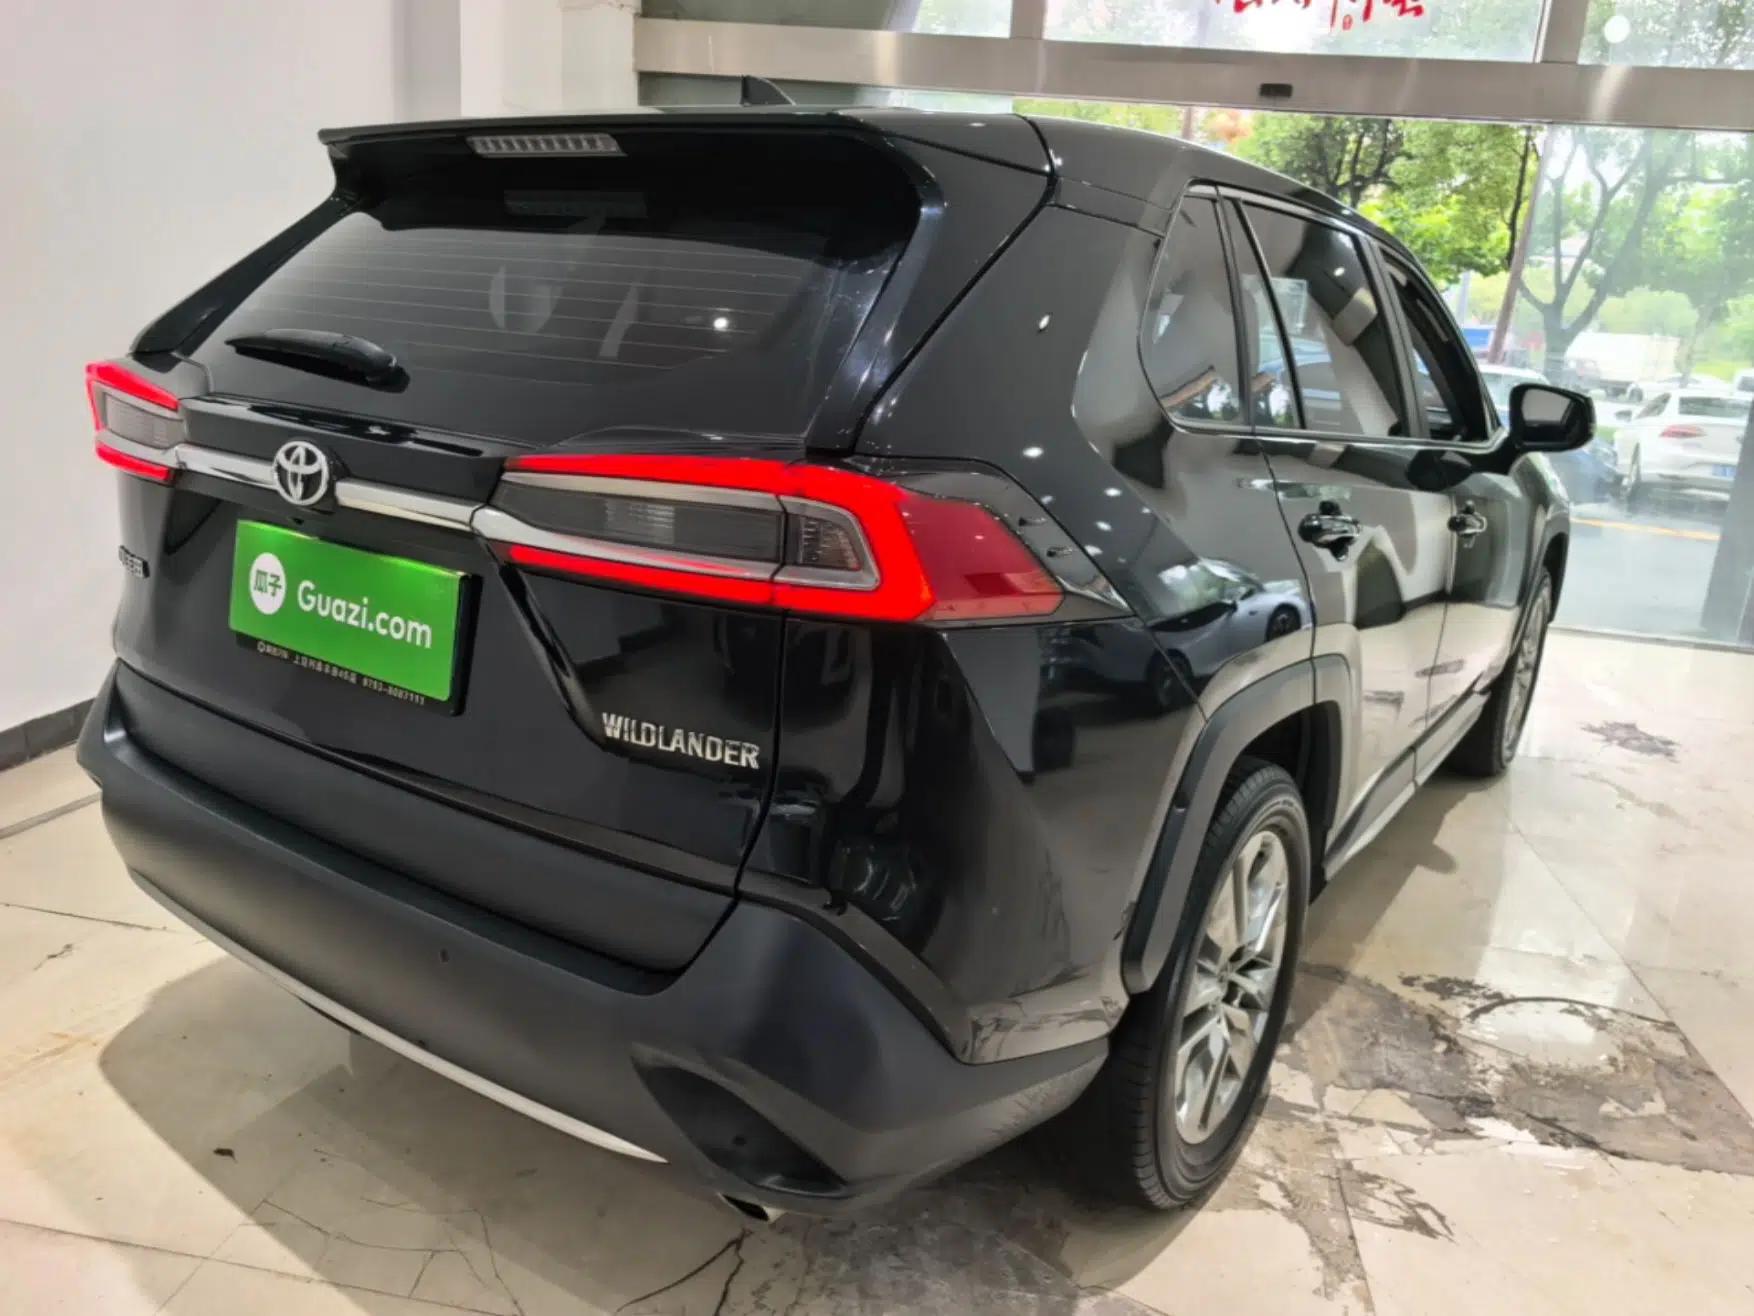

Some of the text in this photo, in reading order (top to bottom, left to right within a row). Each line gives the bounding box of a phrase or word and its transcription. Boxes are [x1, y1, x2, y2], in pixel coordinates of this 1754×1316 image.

[253, 568, 283, 598] 瓜子
[297, 579, 432, 649] Guazi.com
[602, 712, 760, 770] WILDLANDER
